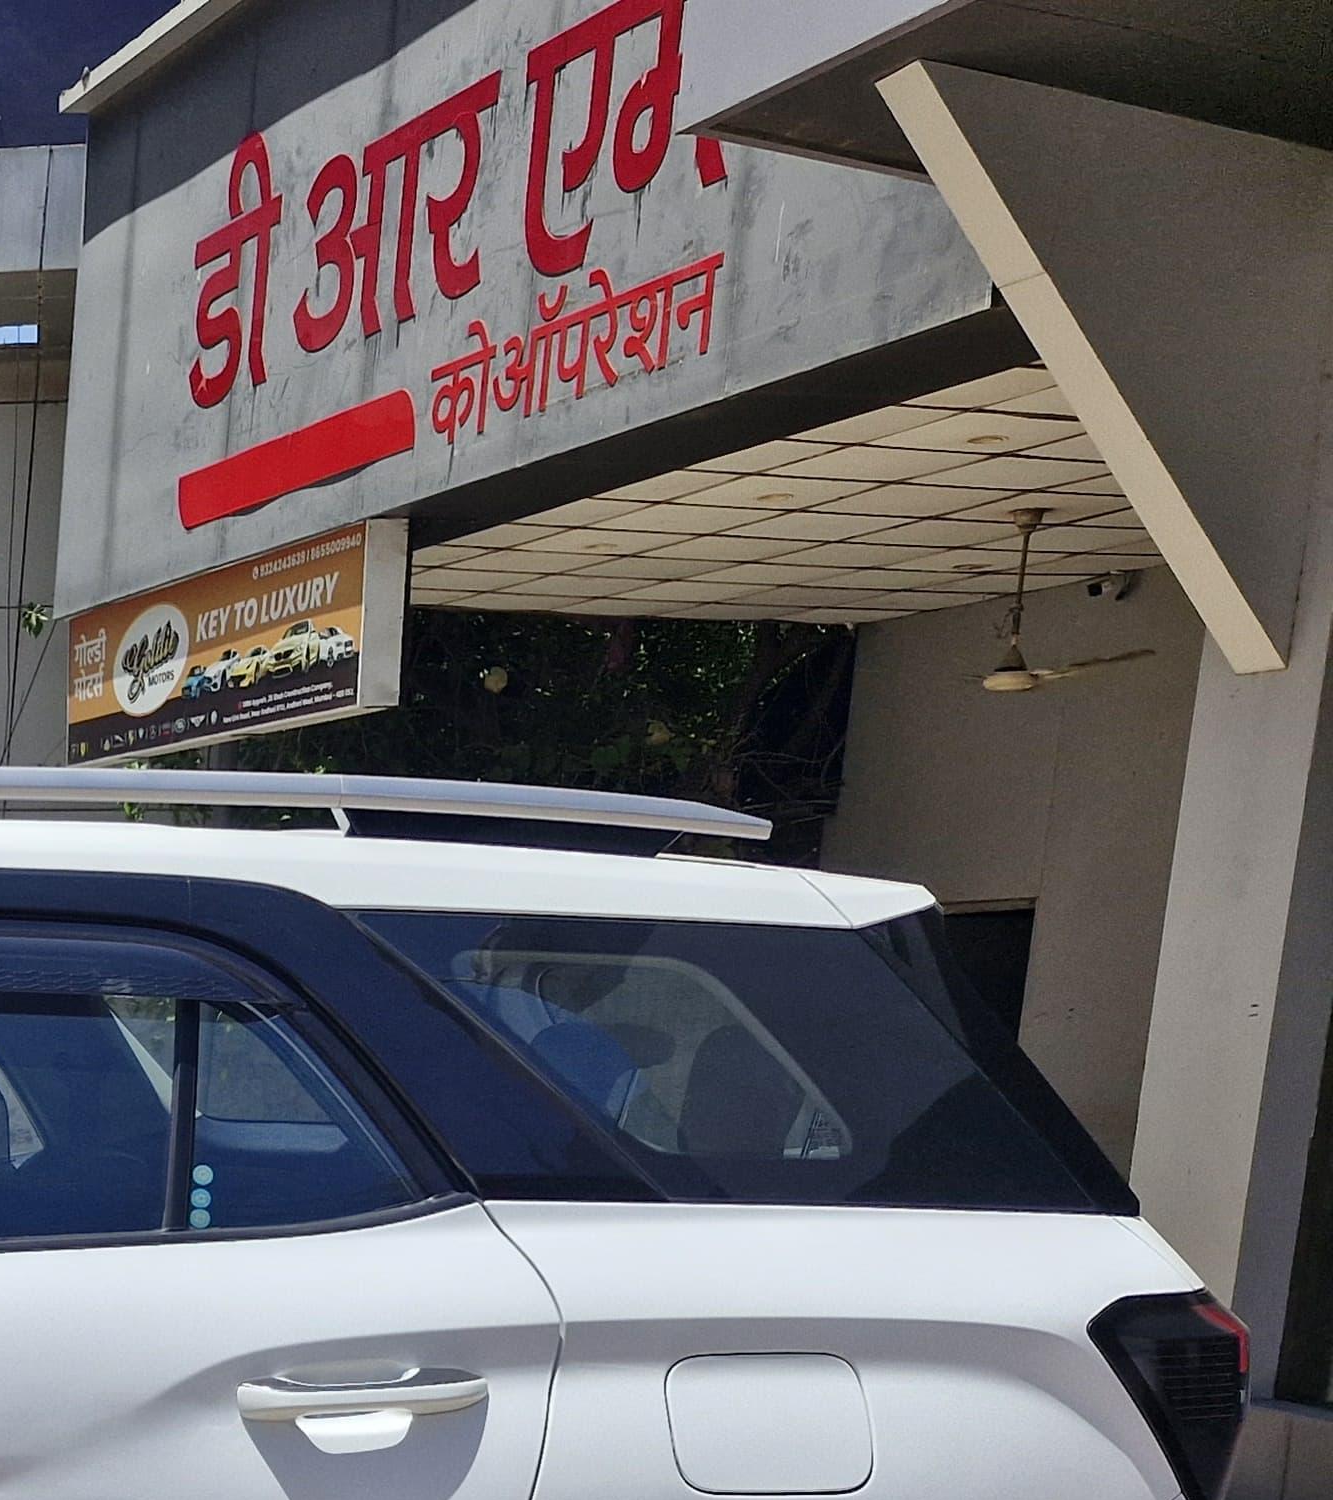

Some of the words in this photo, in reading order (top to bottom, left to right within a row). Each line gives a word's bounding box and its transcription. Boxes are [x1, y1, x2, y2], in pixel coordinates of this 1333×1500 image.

[188, 131, 283, 409] डी
[293, 69, 502, 354] आर
[430, 252, 725, 446] कोऑपरेशन
[196, 605, 232, 643] KEY
[234, 597, 259, 631] TO
[260, 571, 340, 624] LUXURY
[147, 670, 175, 687] MOTORS
